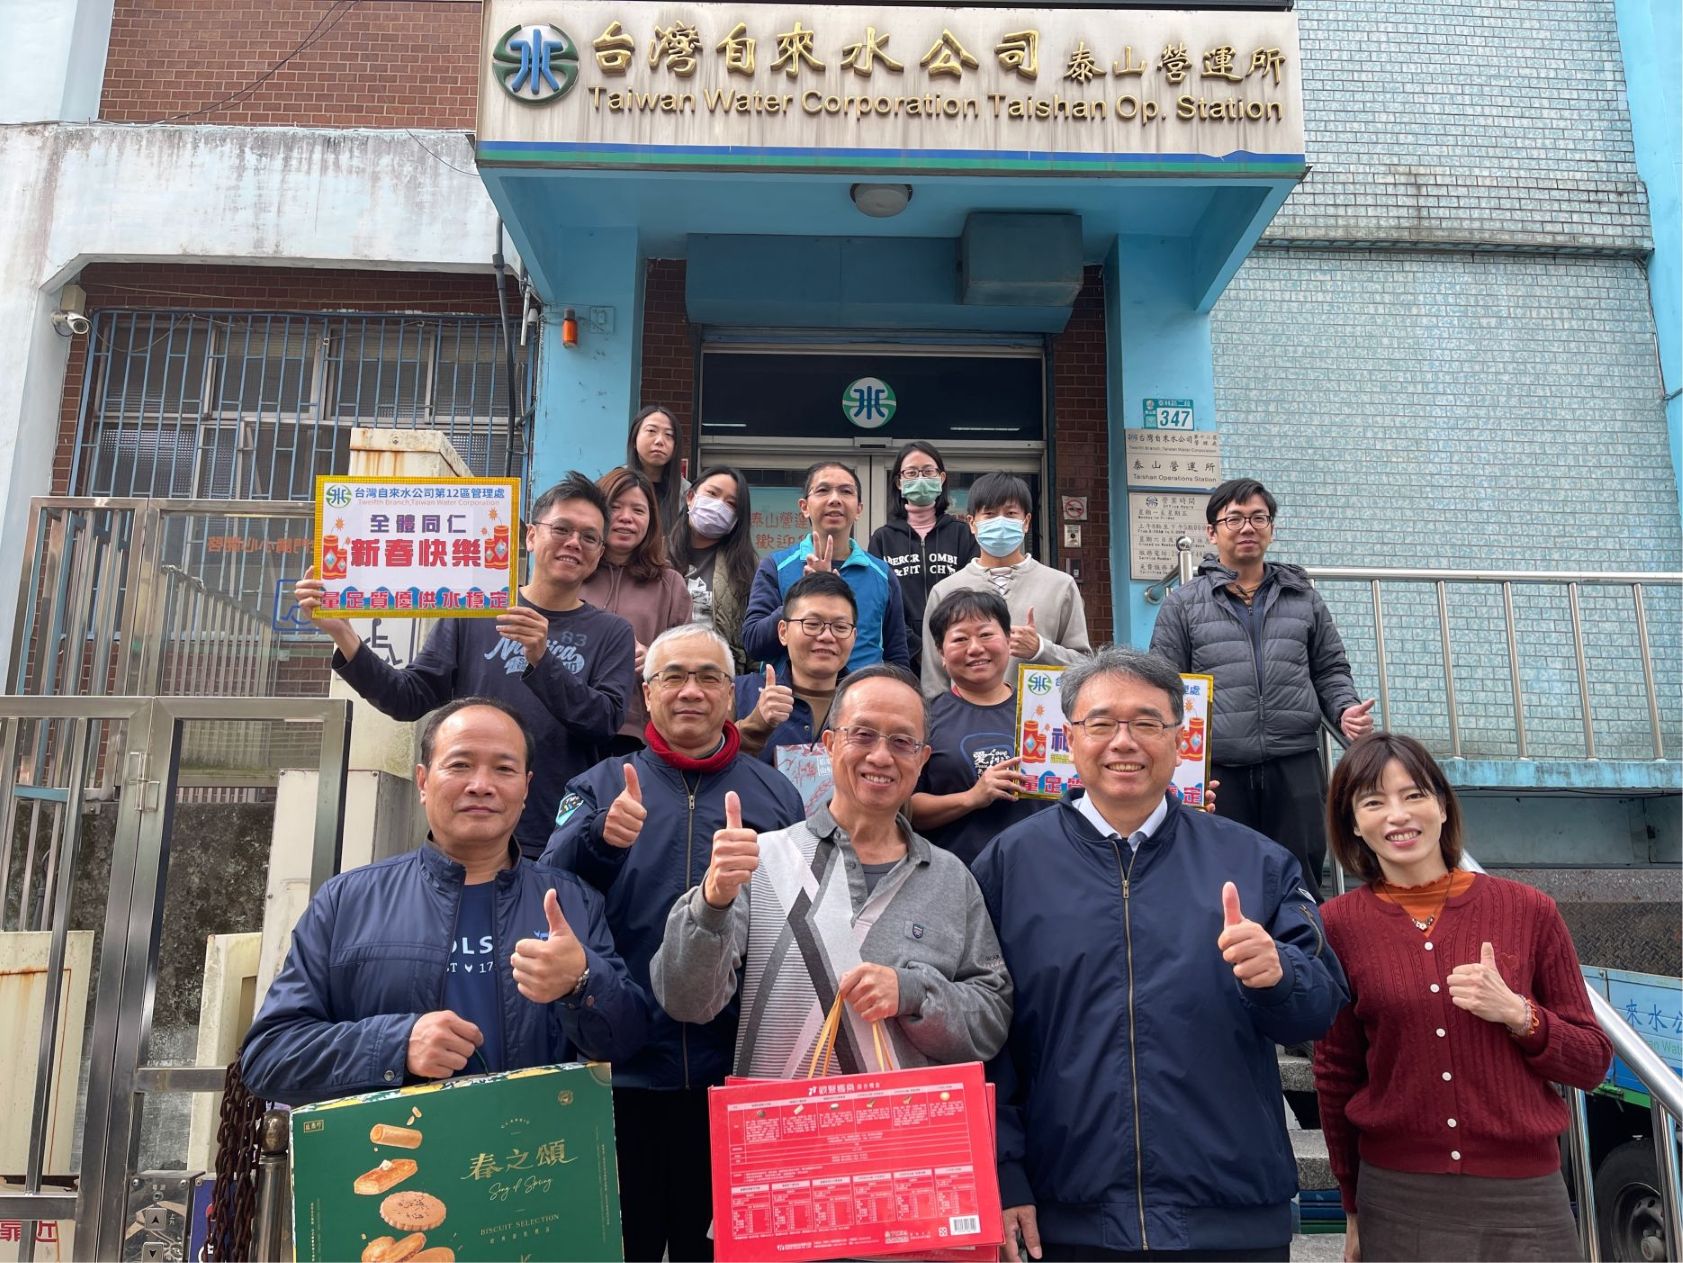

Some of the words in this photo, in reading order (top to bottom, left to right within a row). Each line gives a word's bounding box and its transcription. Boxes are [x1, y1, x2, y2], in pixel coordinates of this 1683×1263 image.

[593, 20, 1040, 79] 台灣自來水公司
[1063, 40, 1286, 87] 泰山營運所
[589, 86, 696, 113] Taiwan
[703, 88, 793, 114] Water
[801, 90, 978, 121] Corporation
[987, 94, 1107, 122] Taishan
[1115, 95, 1166, 127] Op.
[1176, 96, 1283, 122] Station
[1160, 410, 1190, 427] 347
[1133, 459, 1215, 473] 泰山營運所
[1159, 474, 1192, 482] Operations
[355, 487, 505, 499] 台灣自來水公司第12區管理處
[370, 514, 466, 533] 全體同仁
[351, 538, 481, 567] 新春快樂
[321, 590, 508, 609] 量足質優供水穩定
[561, 630, 587, 647] 83
[451, 936, 494, 954] LS
[460, 1138, 578, 1180] 春之頌
[524, 1175, 552, 1193] Spring
[480, 1223, 513, 1236] BISCUIT
[515, 1213, 560, 1228] SELECTION
